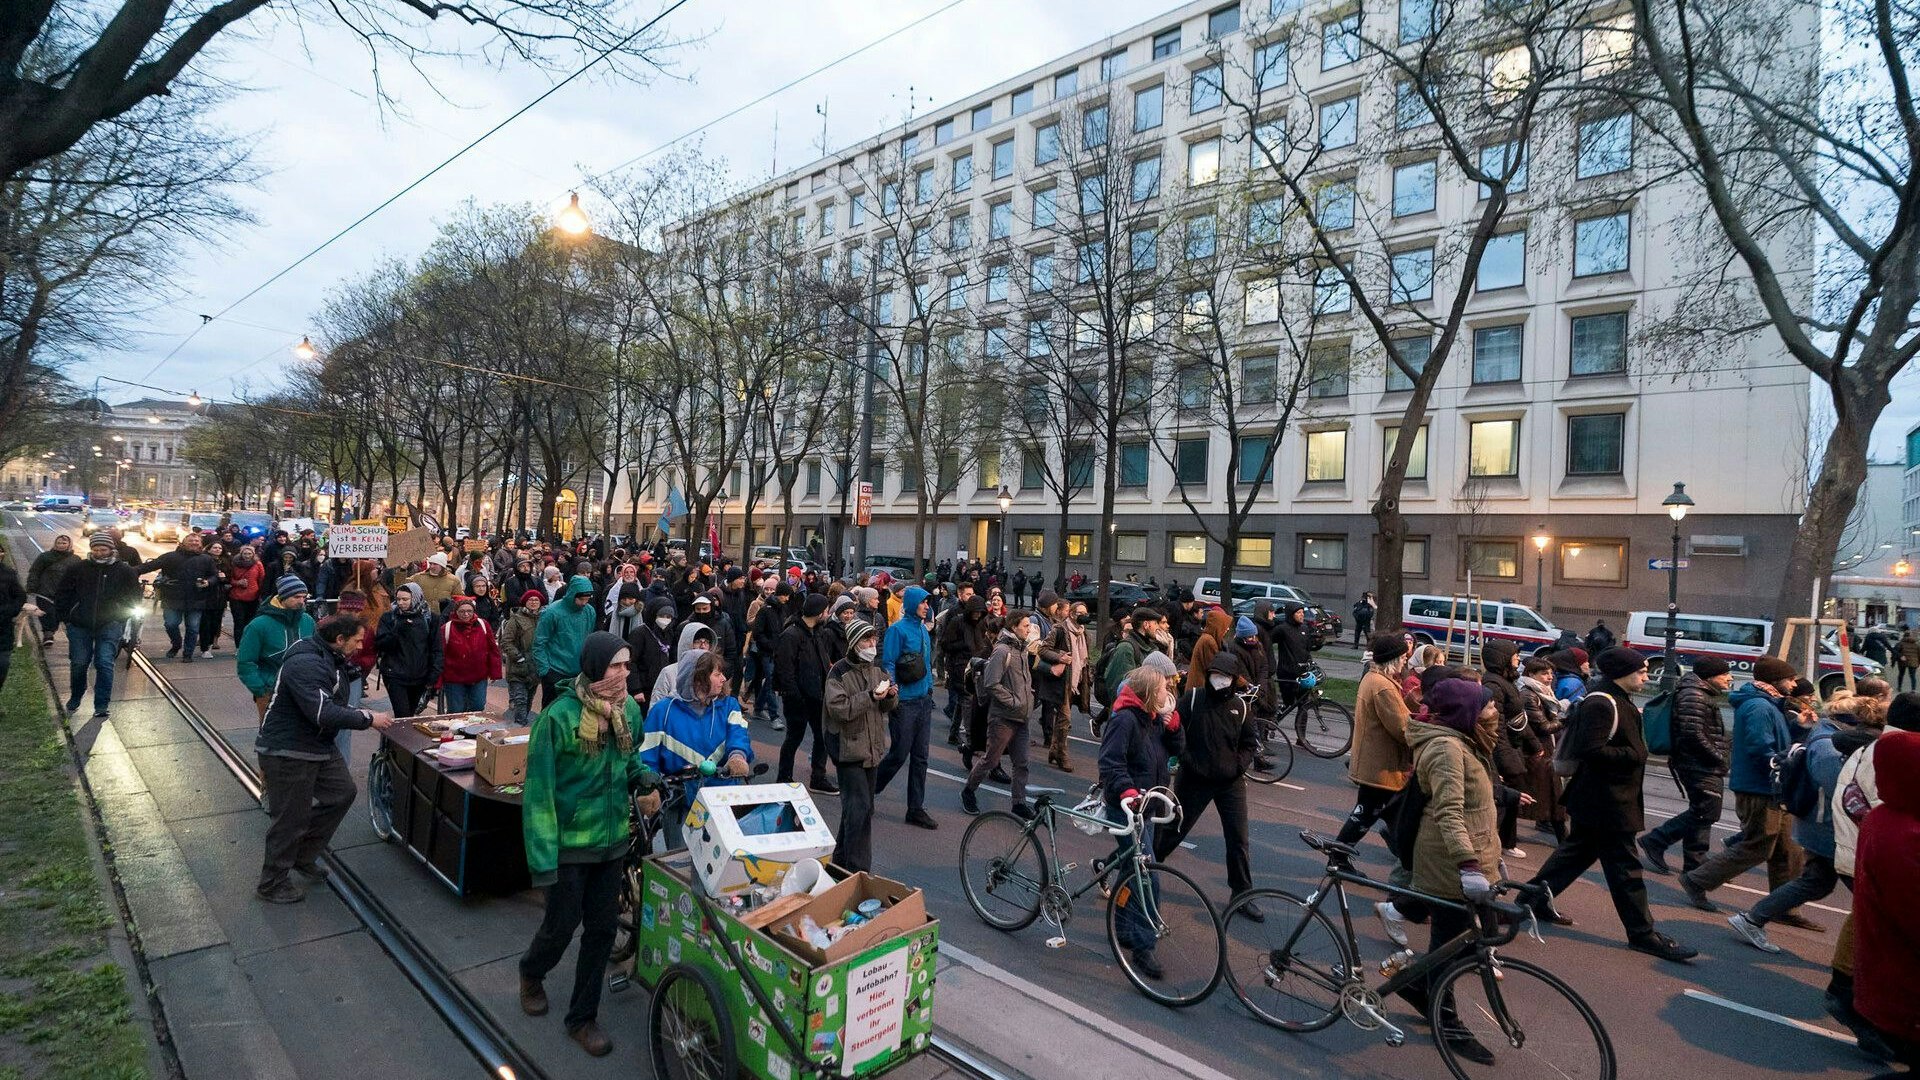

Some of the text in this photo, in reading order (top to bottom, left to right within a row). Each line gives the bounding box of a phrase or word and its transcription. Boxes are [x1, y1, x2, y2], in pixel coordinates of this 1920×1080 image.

[330, 526, 388, 535] KLIMASCHUTZ
[862, 963, 888, 978] Lobau
[856, 970, 899, 995] Autobahn?
[869, 989, 887, 1003] Hier
[856, 998, 895, 1022] verbrennt
[869, 1018, 881, 1029] ihr
[851, 1021, 897, 1052] Steuergeld!
